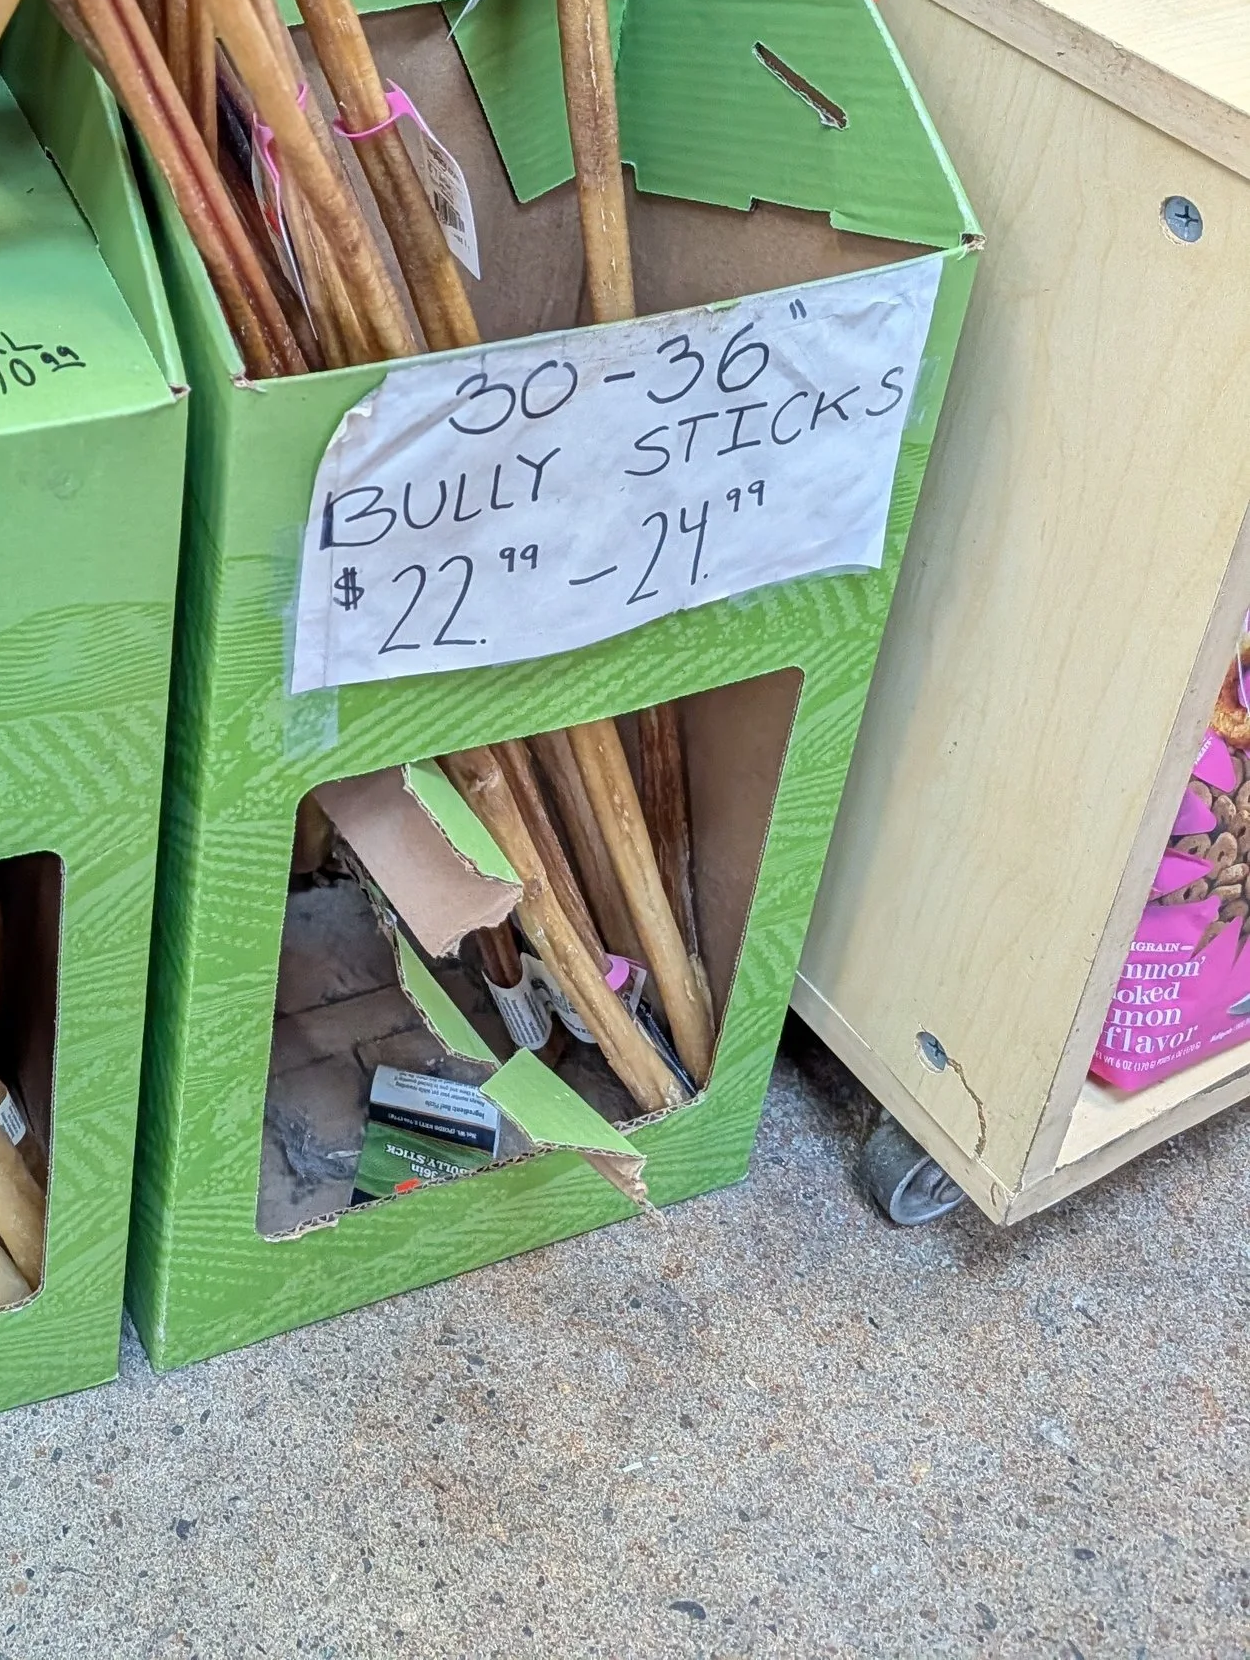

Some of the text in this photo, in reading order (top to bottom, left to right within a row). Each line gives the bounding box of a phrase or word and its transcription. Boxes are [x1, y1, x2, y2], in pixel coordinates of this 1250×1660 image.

[319, 366, 903, 550] BULLY STICKS
[1113, 982, 1180, 1005] oked
[1108, 1007, 1181, 1027] mon
[1104, 1025, 1199, 1054] flavor
[385, 1143, 427, 1165] STICK
